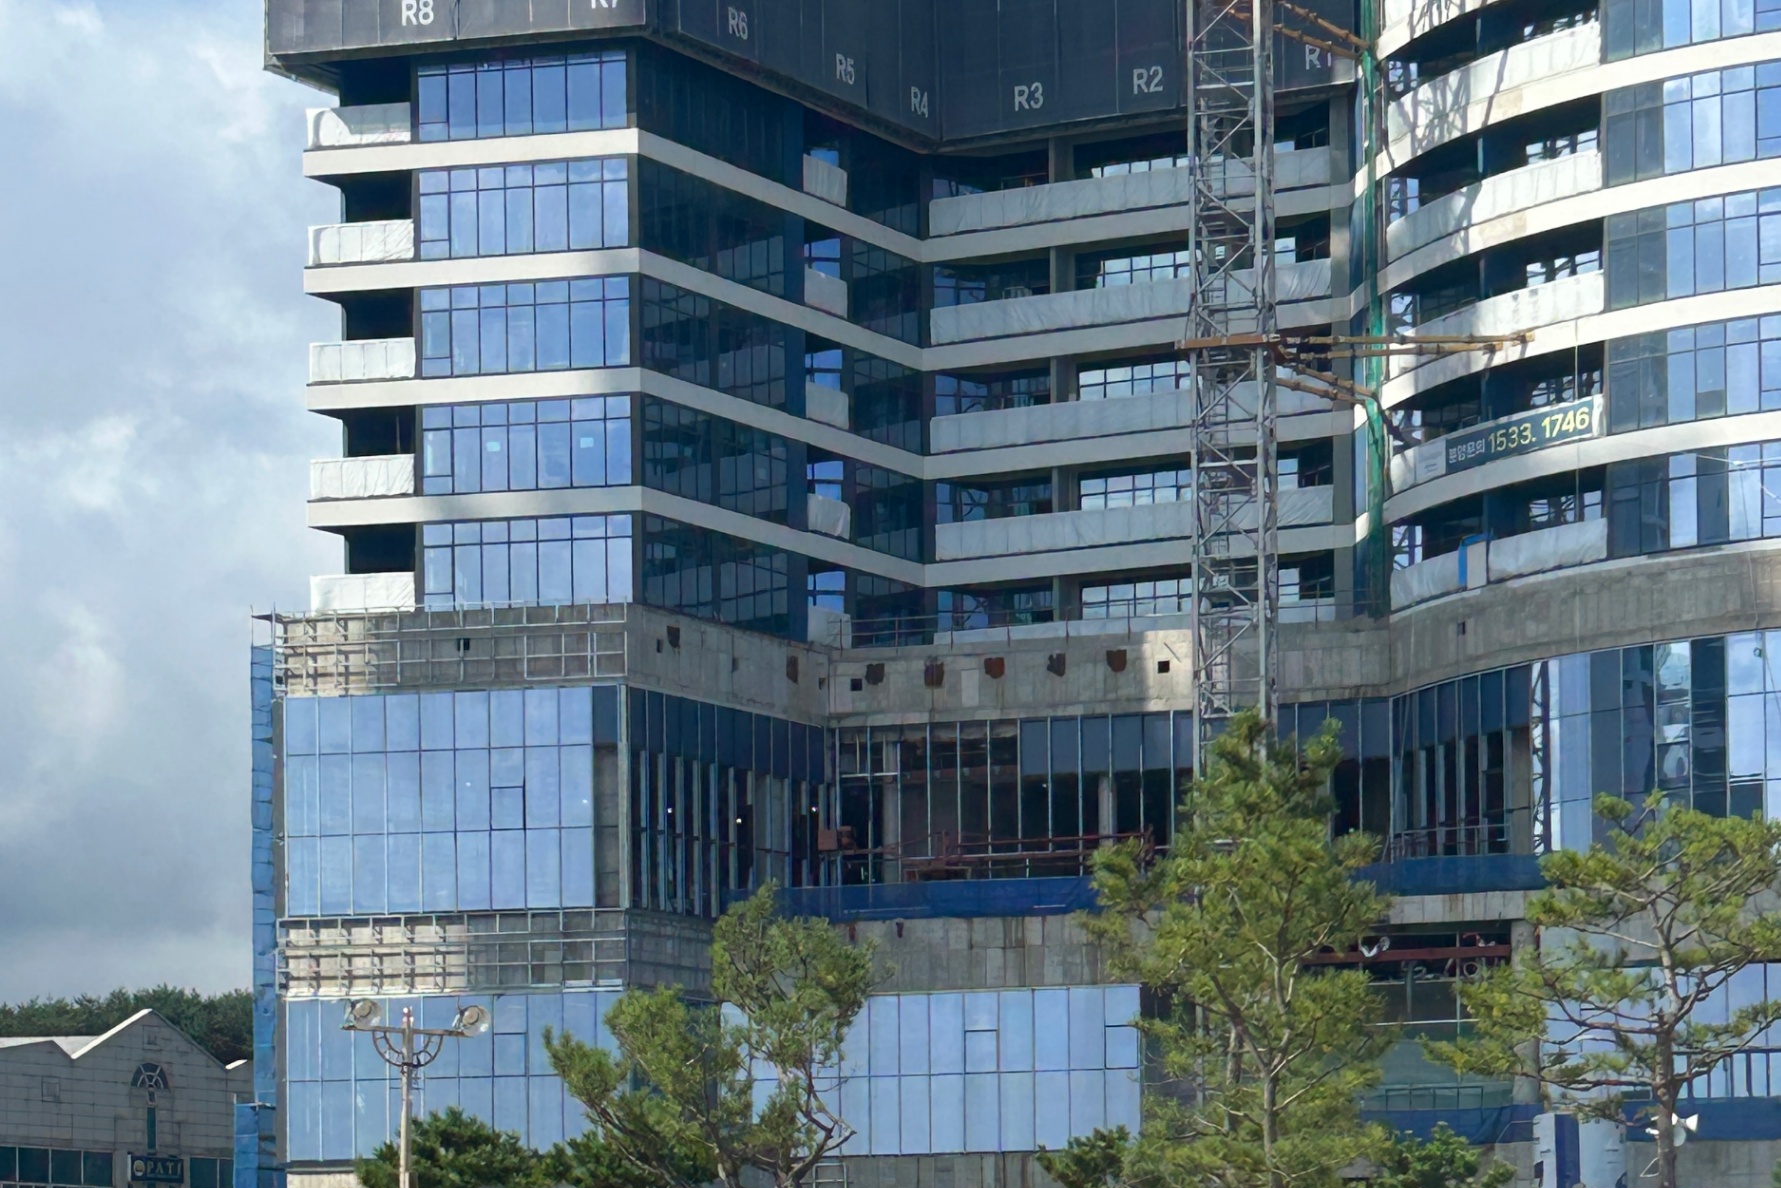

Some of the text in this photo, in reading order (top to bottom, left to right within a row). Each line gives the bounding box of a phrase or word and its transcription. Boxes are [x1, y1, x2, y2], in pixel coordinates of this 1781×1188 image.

[401, 0, 435, 27] R8
[727, 6, 749, 41] R6
[835, 53, 855, 85] R5
[1132, 65, 1164, 95] R2
[910, 85, 929, 118] R4
[1013, 81, 1044, 112] R3
[1448, 438, 1486, 464] 분양문의
[1541, 406, 1591, 439] 1746
